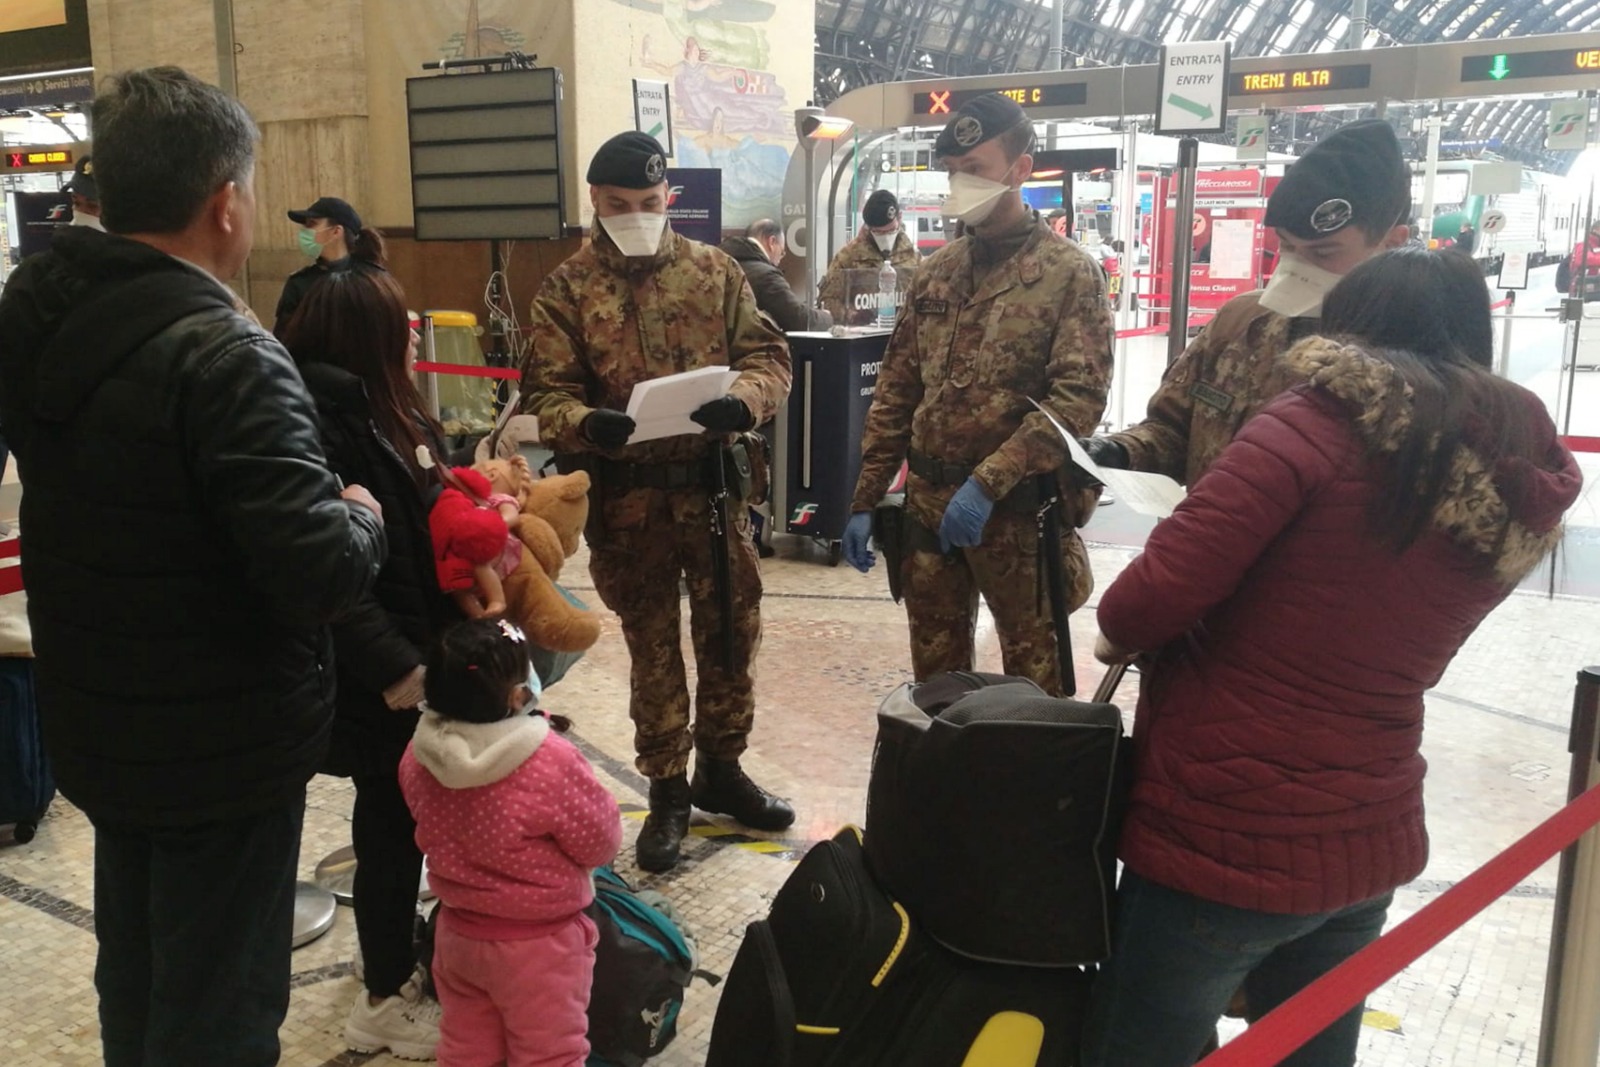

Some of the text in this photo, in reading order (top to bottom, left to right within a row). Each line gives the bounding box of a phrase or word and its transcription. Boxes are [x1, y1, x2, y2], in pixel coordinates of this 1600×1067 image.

[1170, 54, 1222, 66] ENTRATA
[1576, 50, 1600, 68] VE
[44, 78, 70, 91] Servizi
[1176, 73, 1214, 86] ENTRY
[1244, 69, 1330, 90] TRENI ALTA
[636, 90, 662, 100] ENTRATA
[1032, 88, 1041, 102] C
[642, 106, 660, 116] ENTRY
[1212, 284, 1236, 293] Clienti
